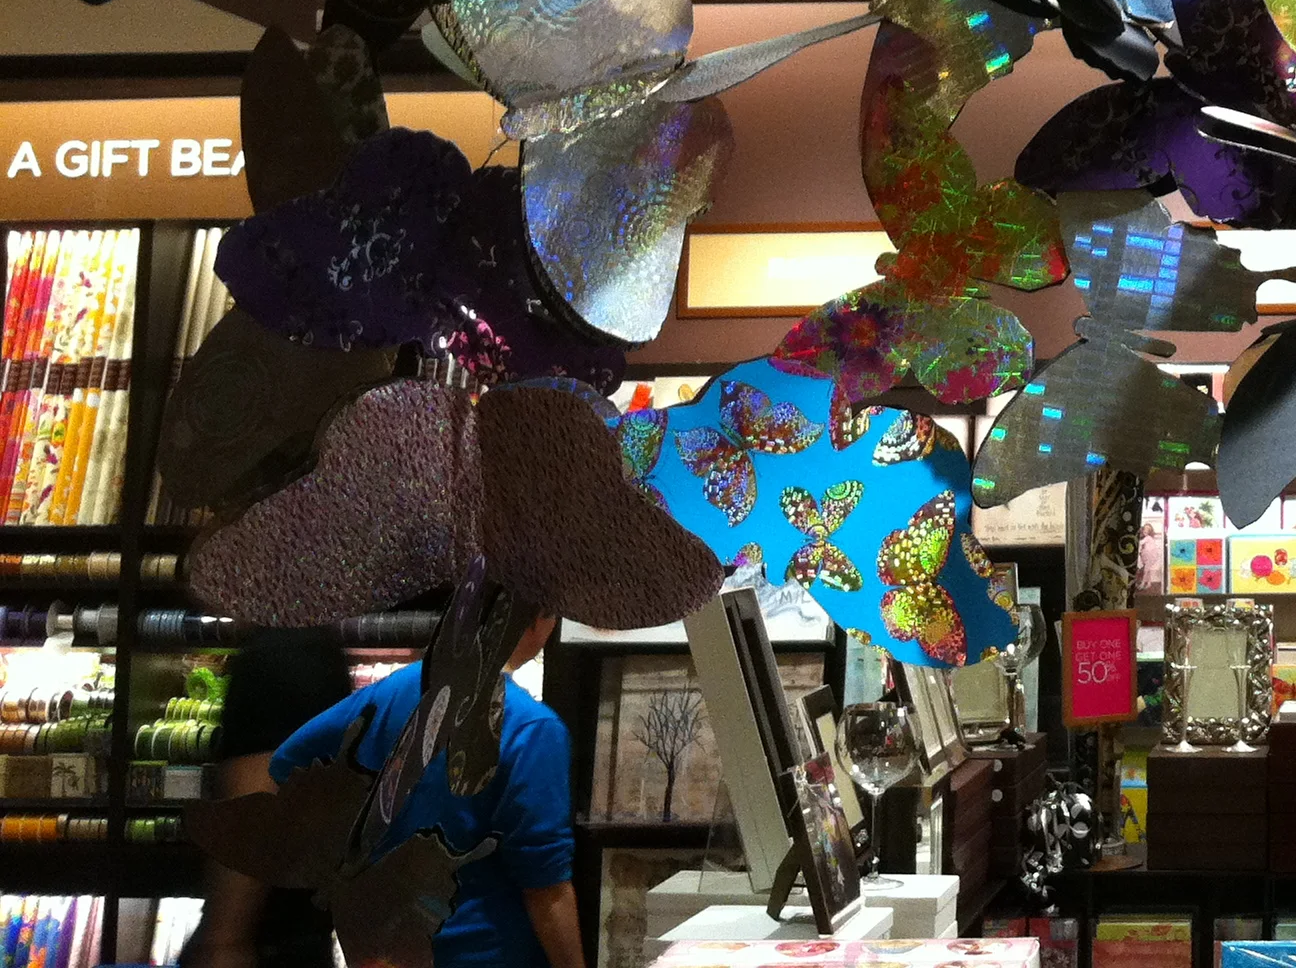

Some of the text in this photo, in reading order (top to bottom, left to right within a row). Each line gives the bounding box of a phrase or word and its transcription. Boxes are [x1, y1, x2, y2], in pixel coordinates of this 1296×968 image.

[7, 138, 246, 178] A GIFT BE
[1076, 639, 1121, 650] BUY ONE
[1075, 651, 1122, 662] GET ONE
